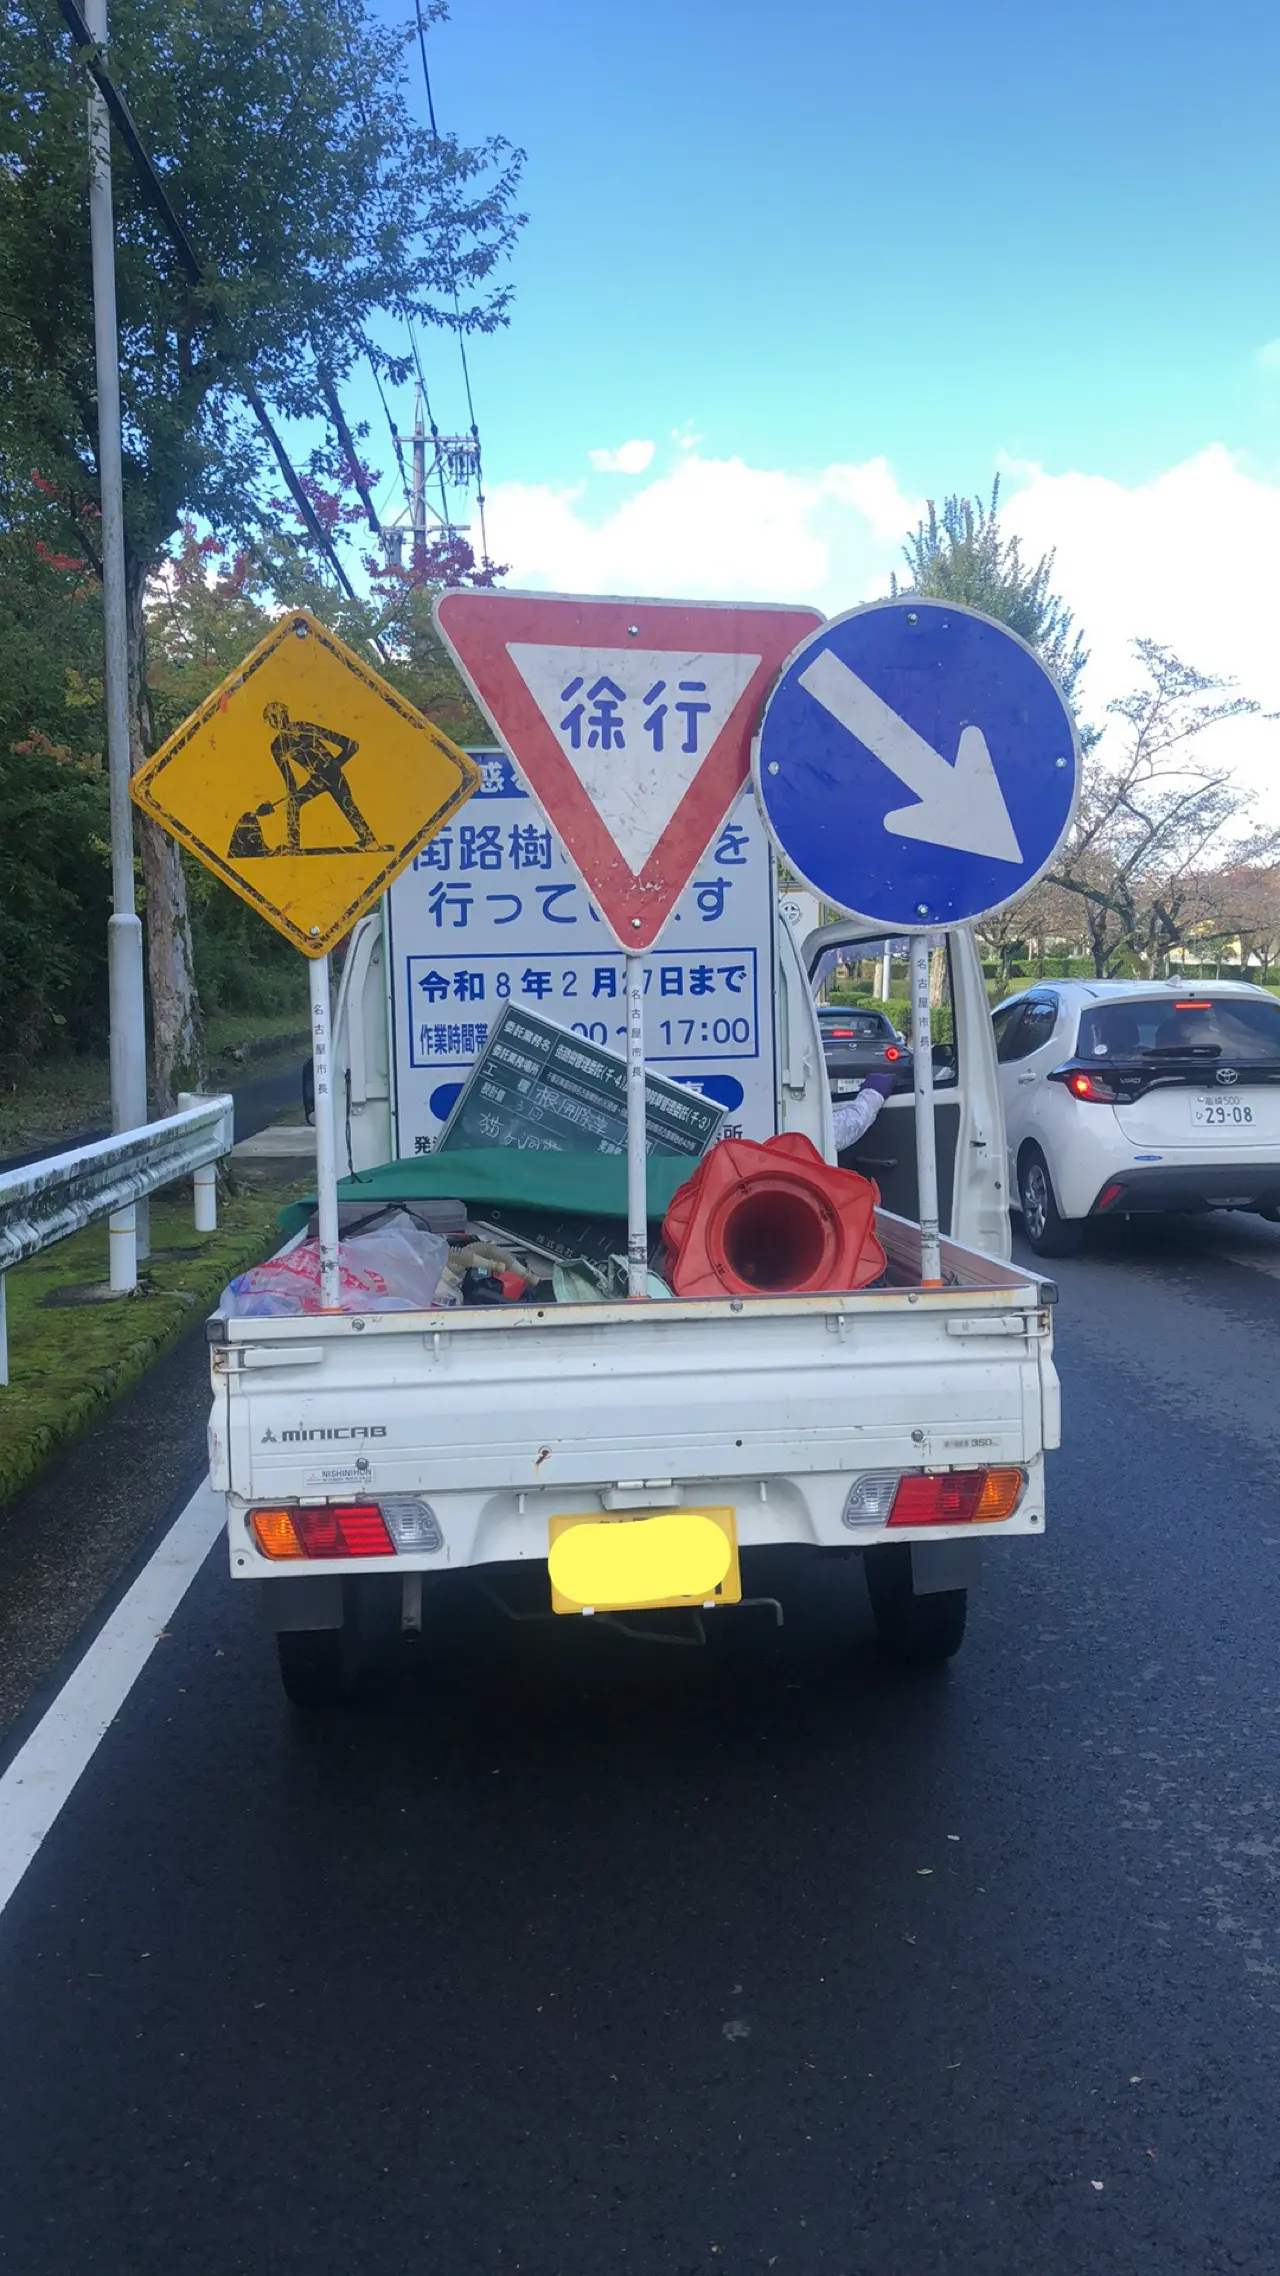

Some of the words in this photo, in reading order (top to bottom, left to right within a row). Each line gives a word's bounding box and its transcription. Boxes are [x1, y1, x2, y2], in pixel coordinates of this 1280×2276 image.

[560, 676, 712, 754] 徐行
[420, 1023, 488, 1055] 作業時間帯
[631, 989, 642, 1077] 名古屋市長
[916, 958, 930, 1048] 名古屋市長
[313, 1004, 328, 1094] 名古屋市長
[282, 1426, 387, 1441] MINICAB
